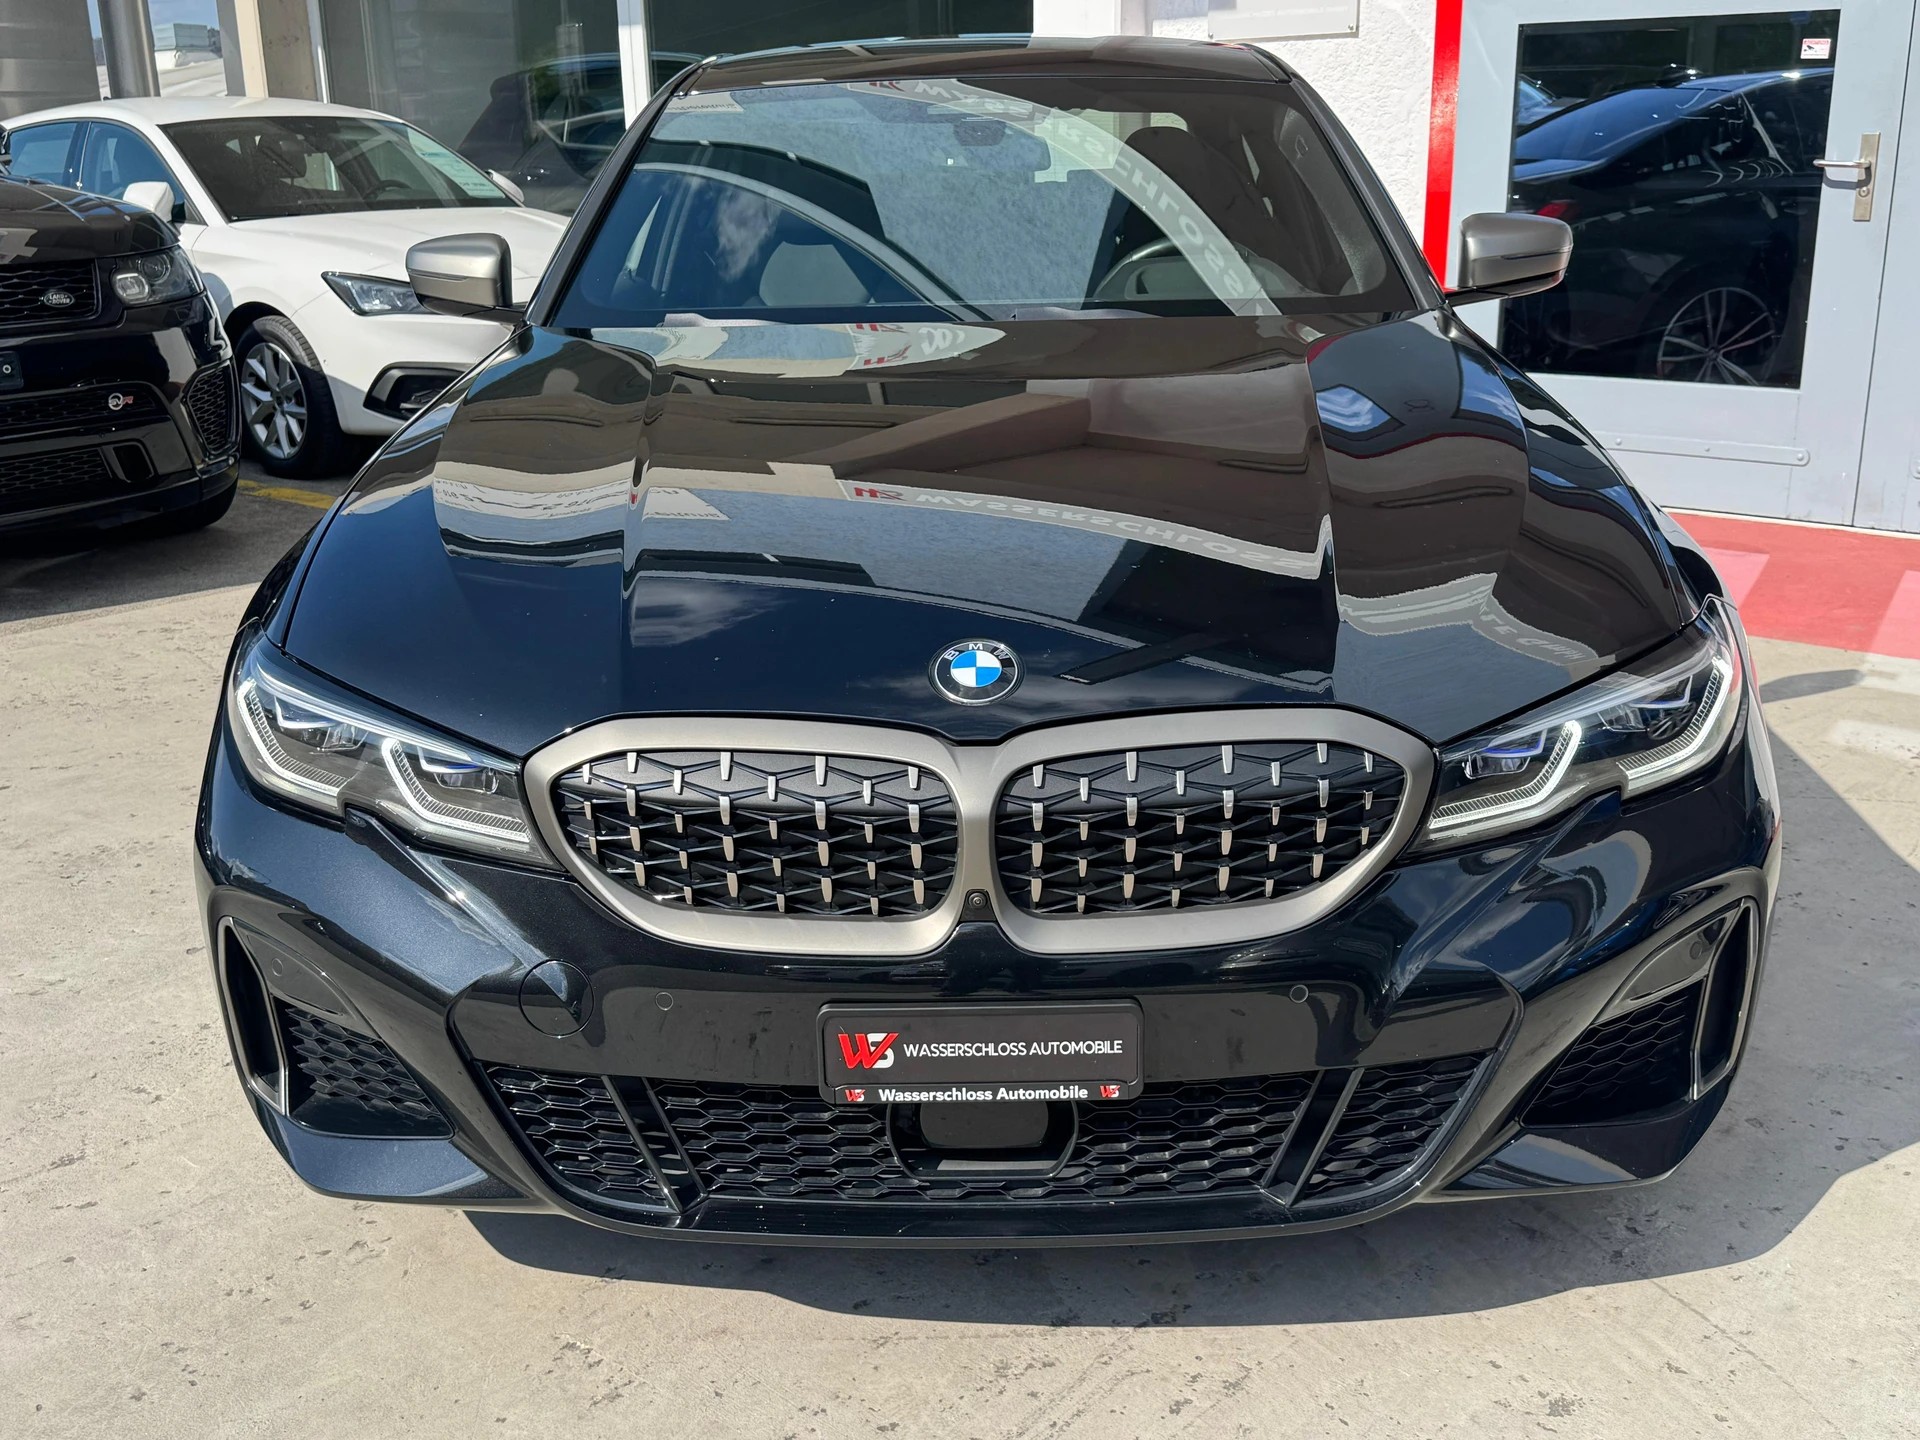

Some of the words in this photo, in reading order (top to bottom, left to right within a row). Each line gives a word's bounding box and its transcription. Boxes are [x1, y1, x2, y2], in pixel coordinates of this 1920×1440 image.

[944, 643, 1010, 660] BMW
[903, 1042, 1027, 1057] WASSERSCHLOSS
[1029, 1040, 1123, 1055] AUTOMOBILE
[878, 1087, 994, 1102] Wasserschloss
[996, 1085, 1088, 1100] Automobile
